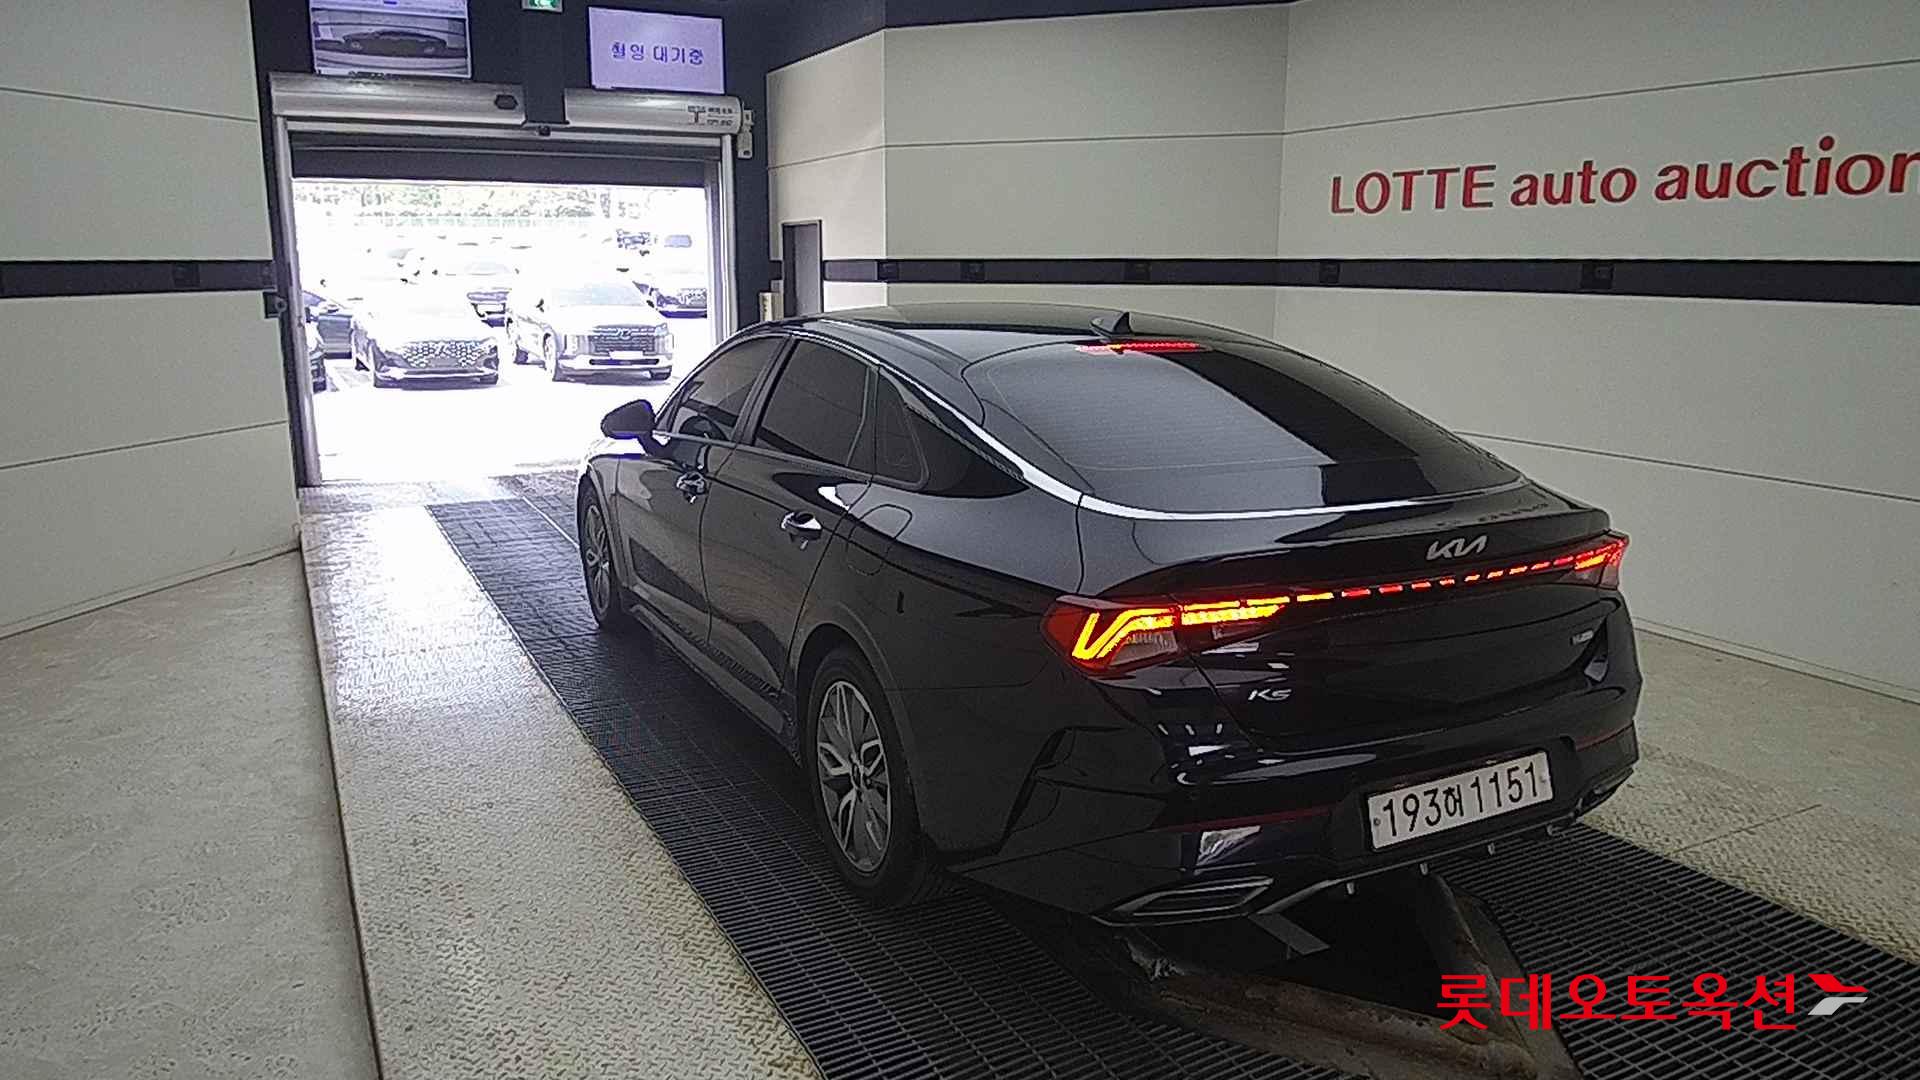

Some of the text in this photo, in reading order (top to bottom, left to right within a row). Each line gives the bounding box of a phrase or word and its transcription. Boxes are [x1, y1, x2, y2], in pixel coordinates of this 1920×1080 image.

[653, 45, 704, 66] 대기중
[1331, 164, 1497, 214] LOTTE
[1510, 160, 1637, 207] auto
[1248, 688, 1292, 701] K5
